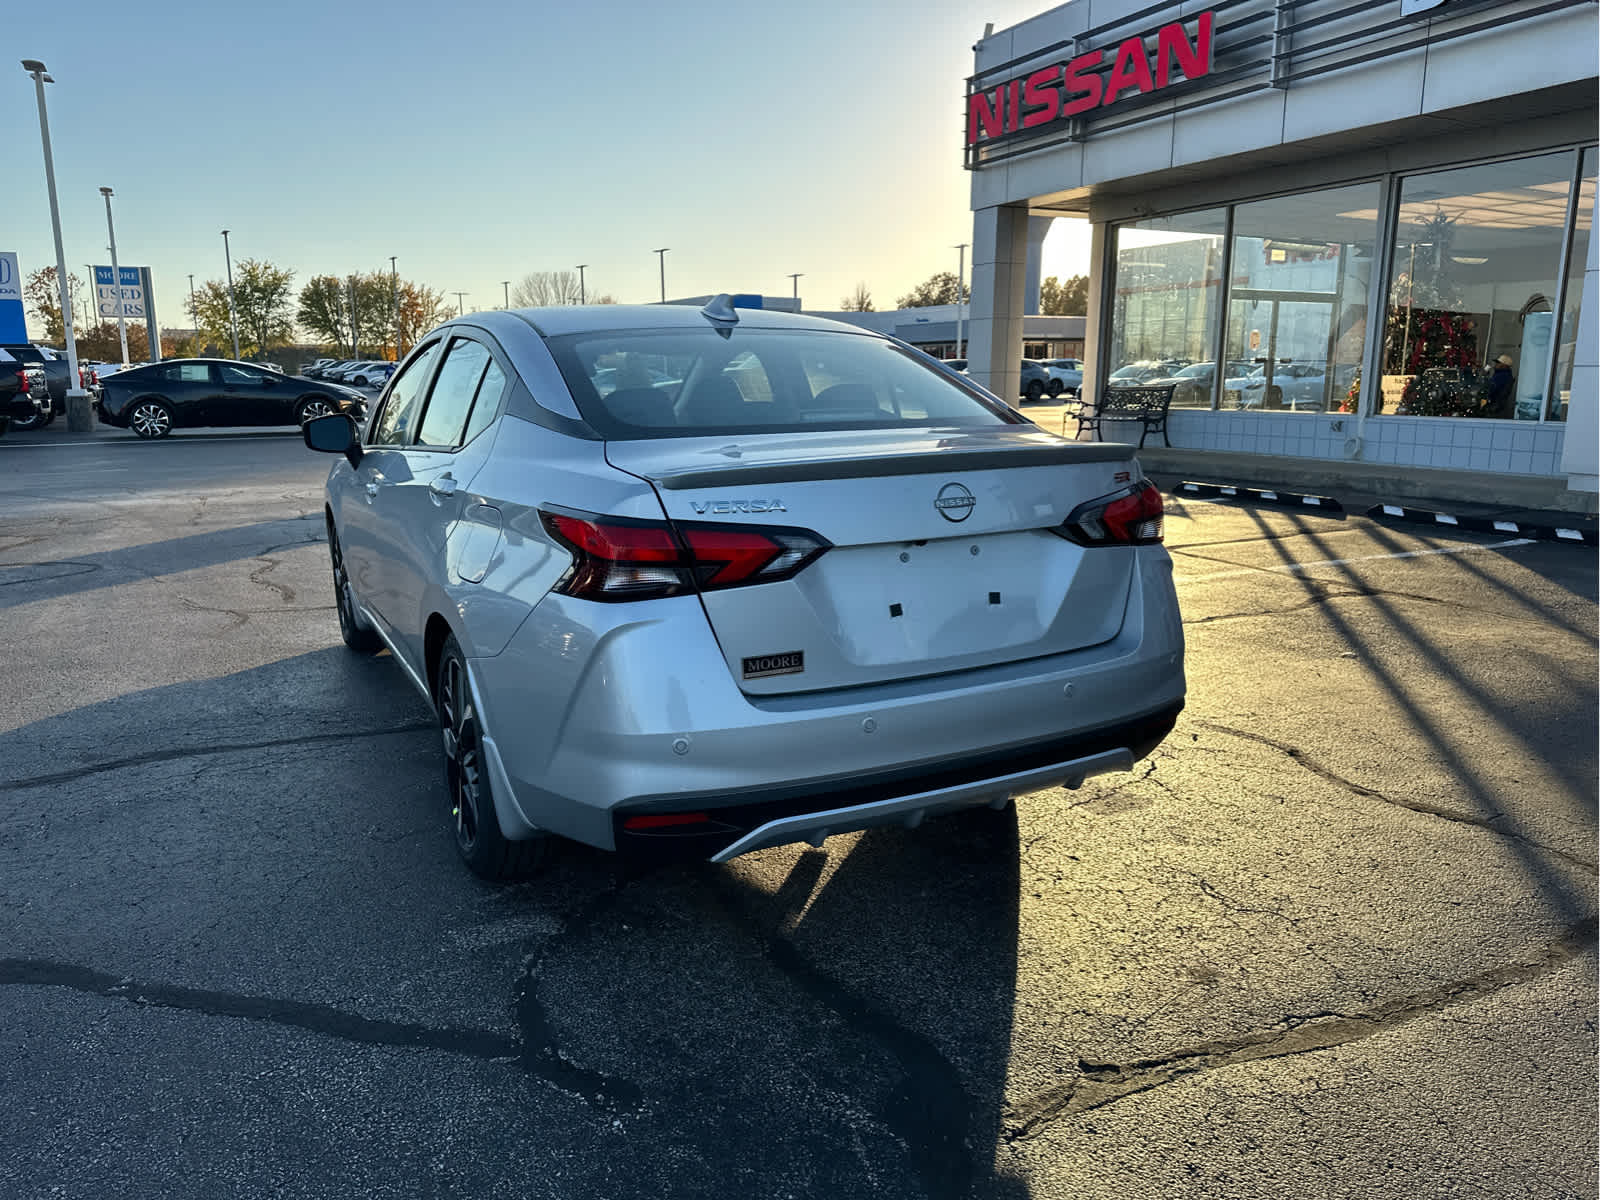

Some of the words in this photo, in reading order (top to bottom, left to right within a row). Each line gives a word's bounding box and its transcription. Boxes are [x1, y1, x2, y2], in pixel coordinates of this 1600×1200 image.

[967, 11, 1214, 145] NISSAN
[688, 499, 788, 514] VERSA
[747, 654, 801, 672] MOORE
